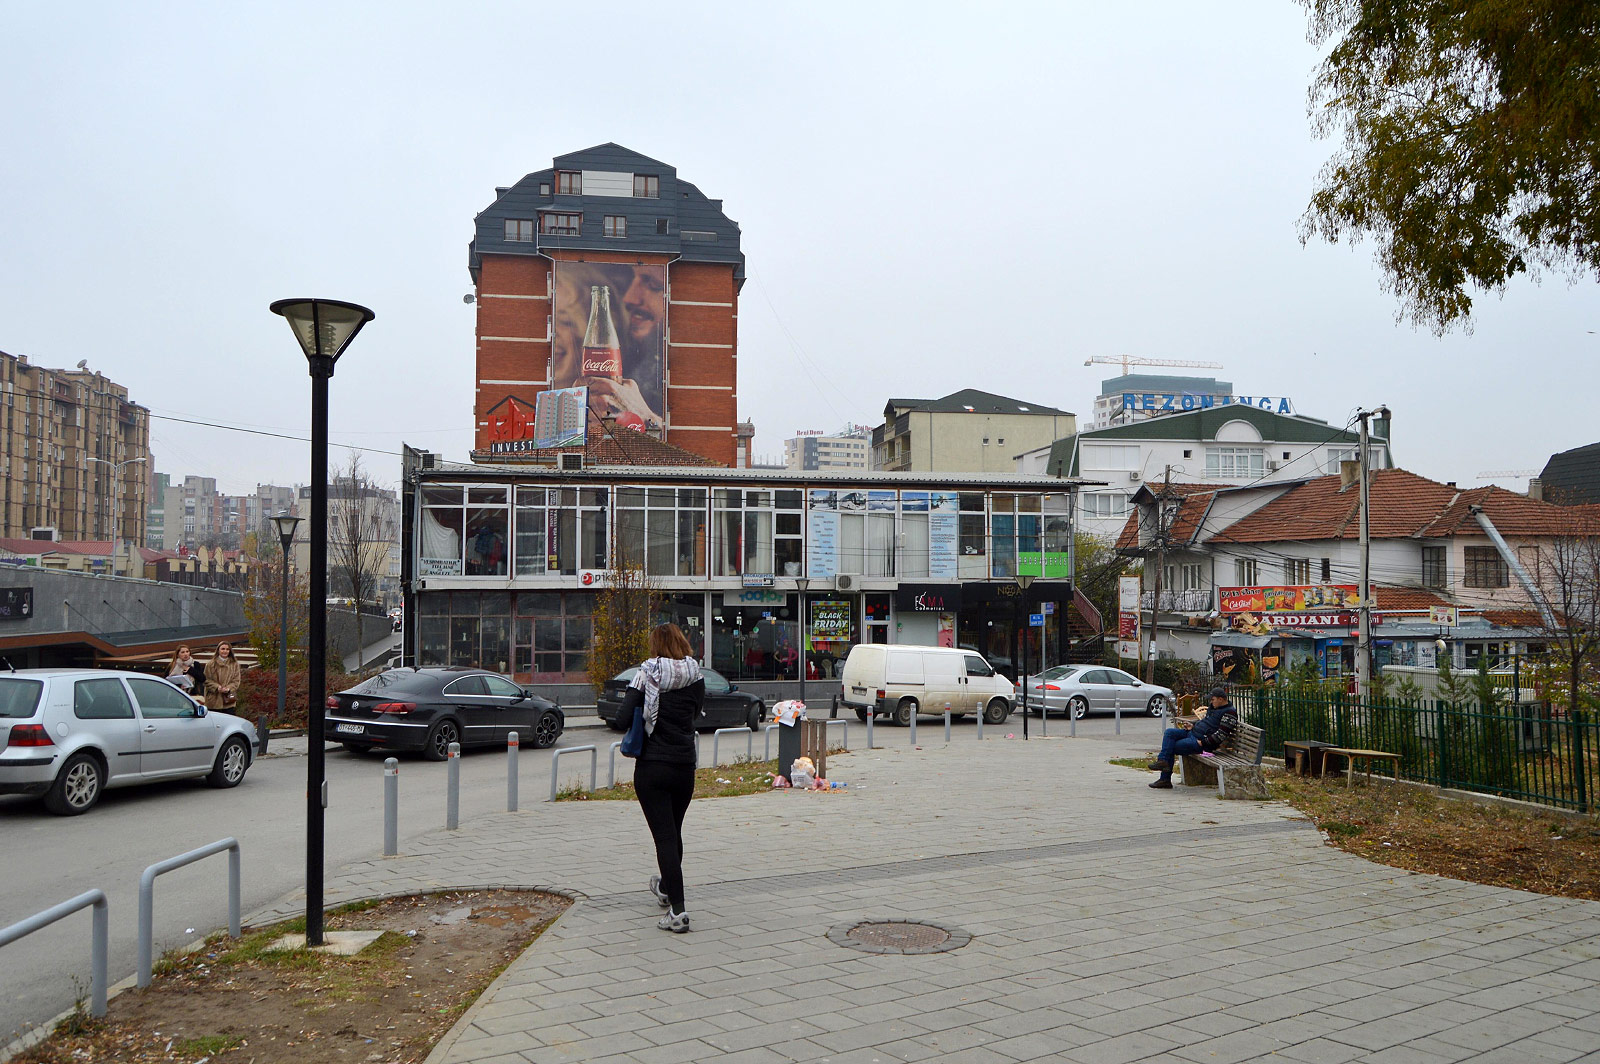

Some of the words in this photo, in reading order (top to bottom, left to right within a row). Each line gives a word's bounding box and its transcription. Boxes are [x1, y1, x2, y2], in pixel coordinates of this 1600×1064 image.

[583, 359, 619, 372] Coca-Cola
[1123, 393, 1291, 414] REZONANCA
[491, 440, 533, 453] INVEST
[814, 620, 848, 628] FRIDAY
